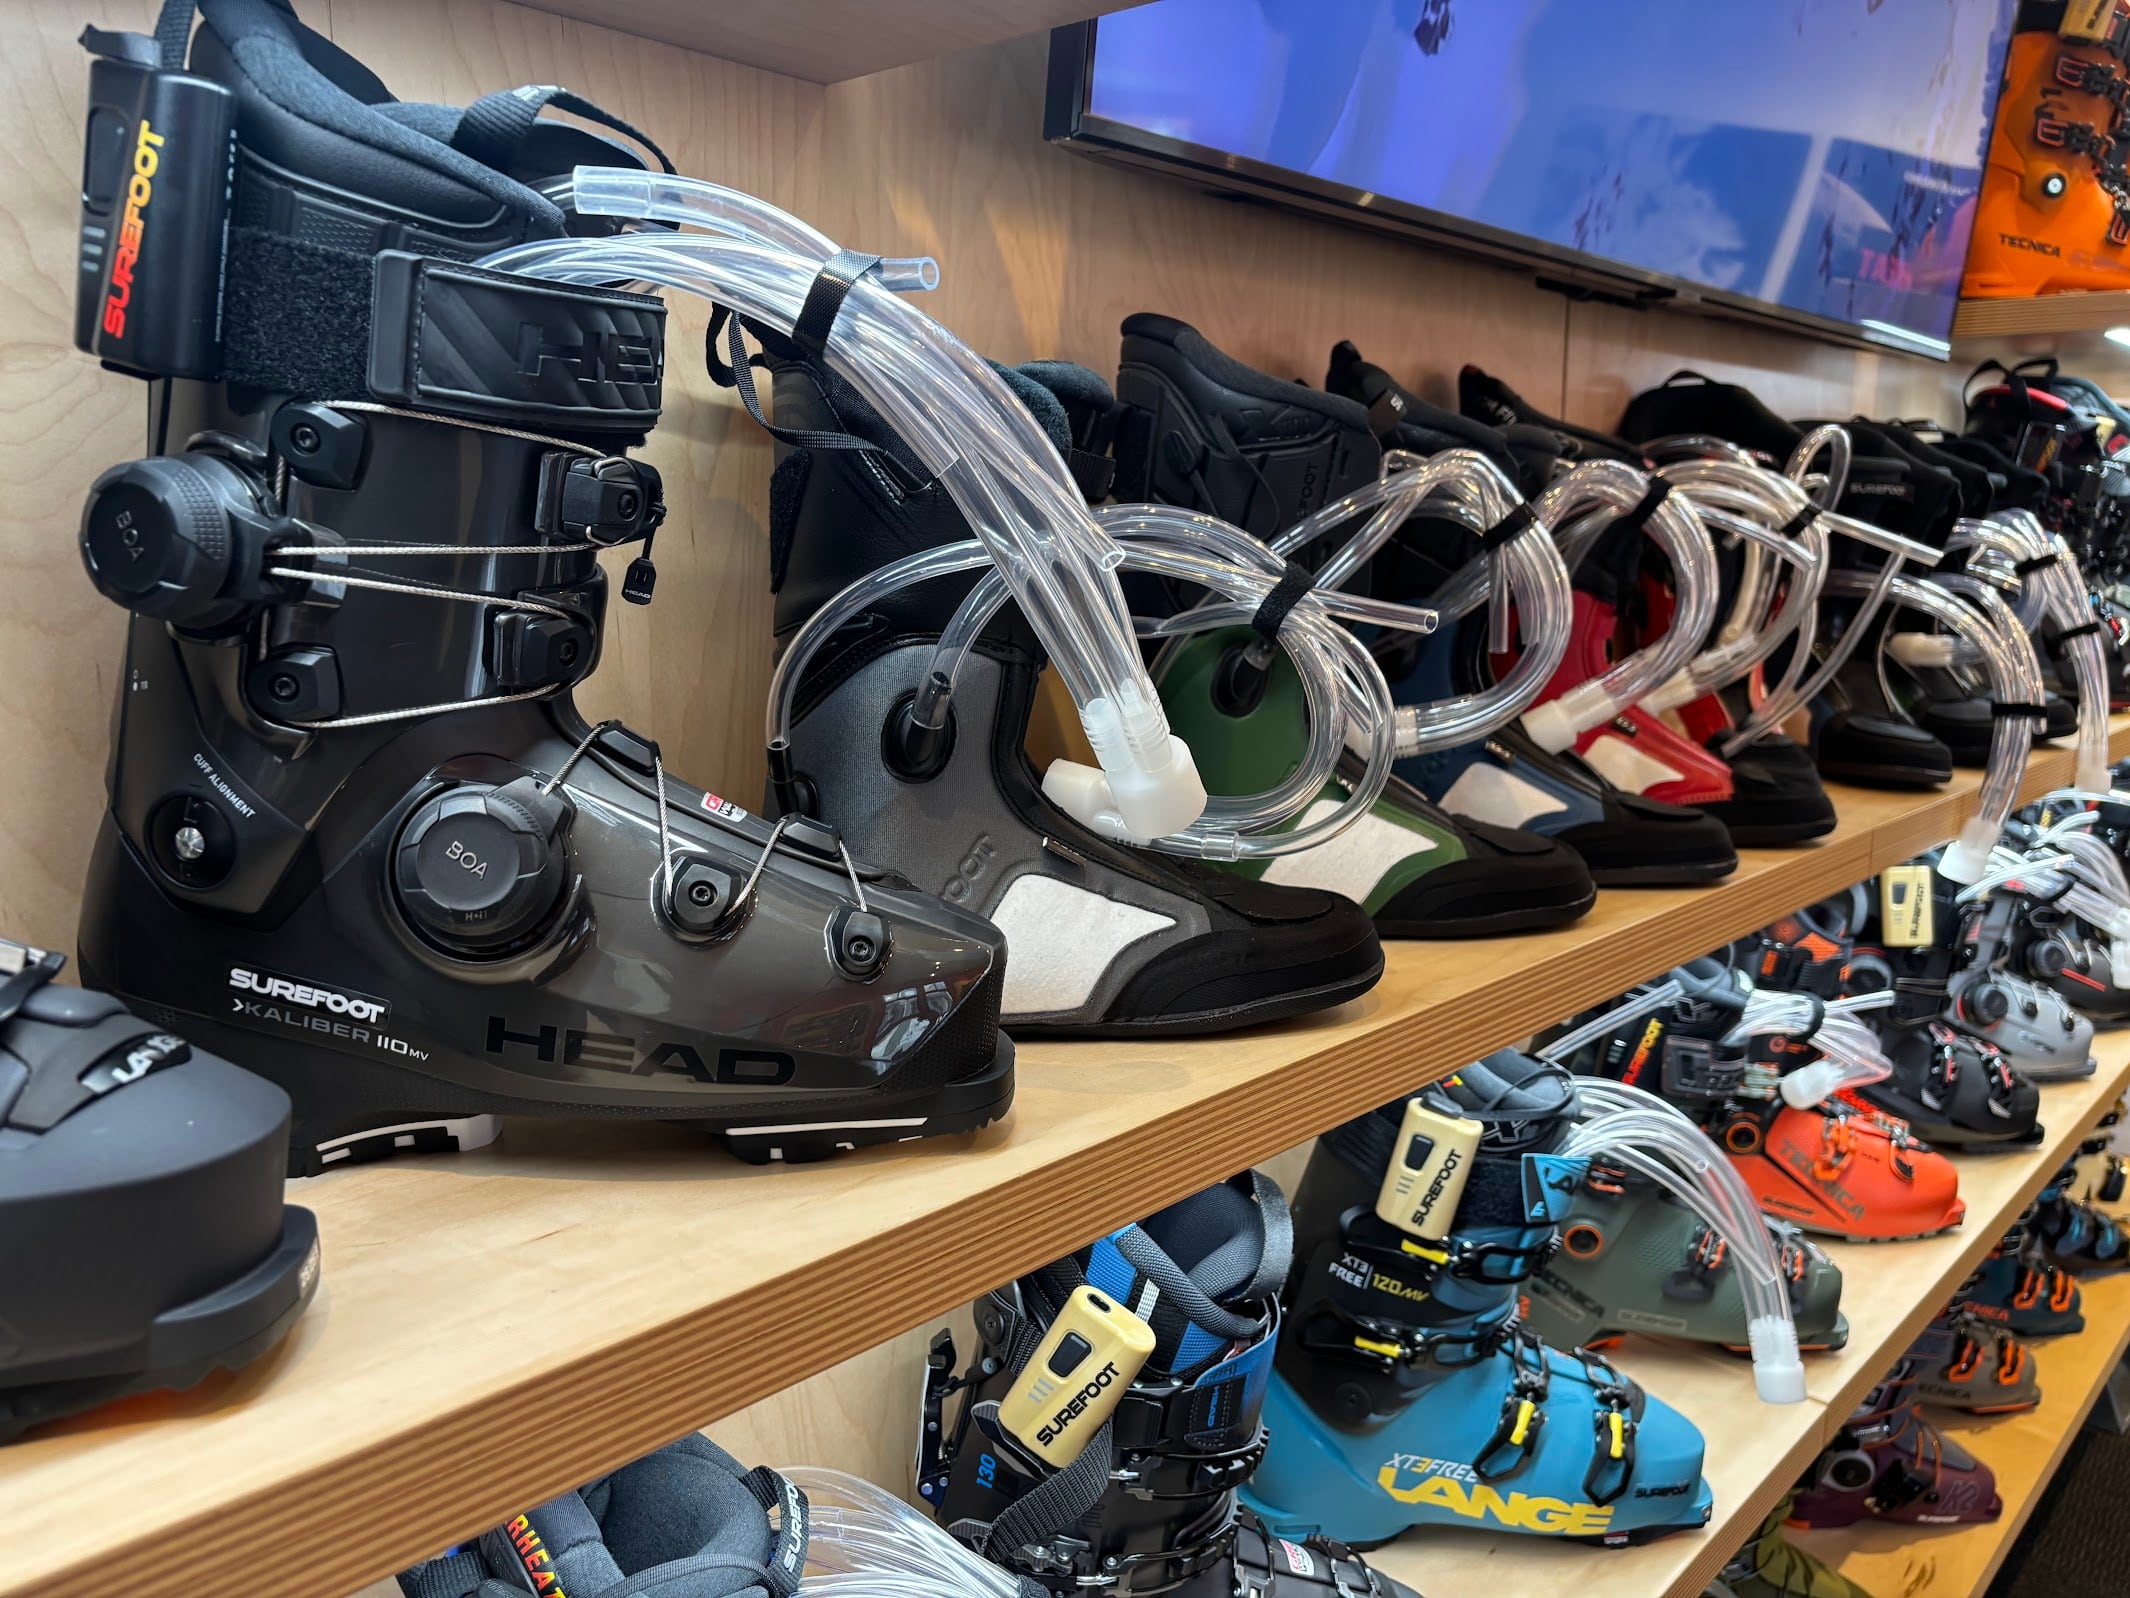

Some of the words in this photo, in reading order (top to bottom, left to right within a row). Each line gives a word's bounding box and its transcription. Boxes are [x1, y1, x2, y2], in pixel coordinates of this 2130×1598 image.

[104, 119, 165, 340] SUREFOOT
[515, 321, 661, 385] HE
[116, 510, 144, 561] BOA
[193, 753, 213, 773] CUFF
[208, 773, 256, 818] ALIGNMENT
[445, 840, 488, 879] BOA
[229, 967, 385, 1023] SUREFOOT
[486, 1015, 796, 1086] HEAD
[1411, 1148, 1463, 1227] SUREFOOT
[1328, 1262, 1365, 1289] FREE
[1036, 1361, 1120, 1447] SUREFOOT
[976, 1453, 997, 1489] 130
[1378, 1466, 1614, 1535] LANGE
[504, 1513, 567, 1598] RHEAT
[783, 1473, 803, 1573] SUREFO
